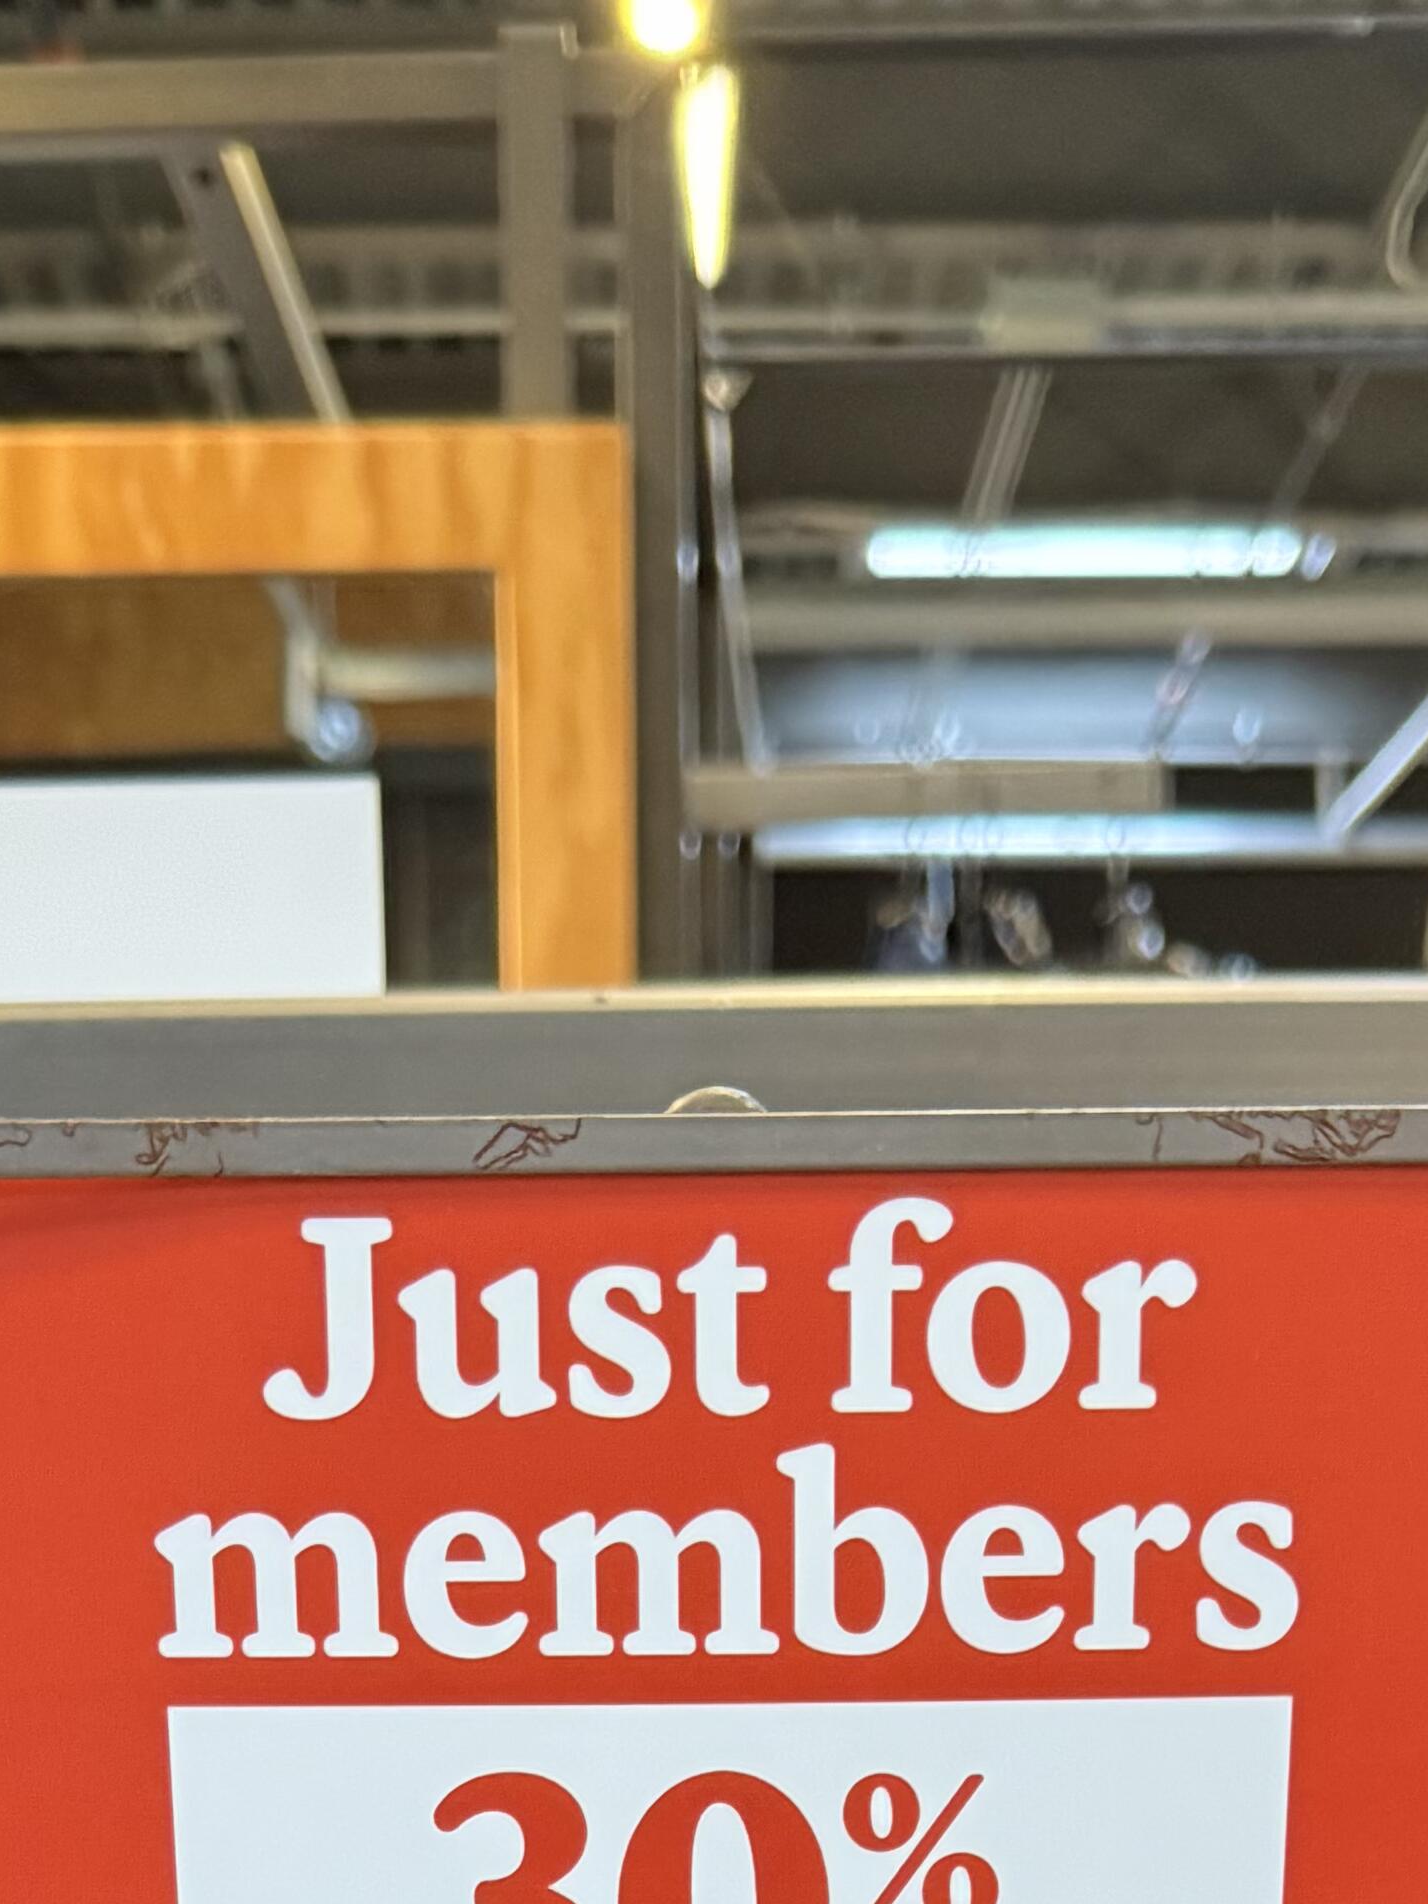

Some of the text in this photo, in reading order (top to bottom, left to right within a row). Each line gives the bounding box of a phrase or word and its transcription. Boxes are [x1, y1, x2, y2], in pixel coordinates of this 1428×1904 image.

[262, 1196, 1198, 1422] Just for
[153, 1441, 1300, 1660] members
